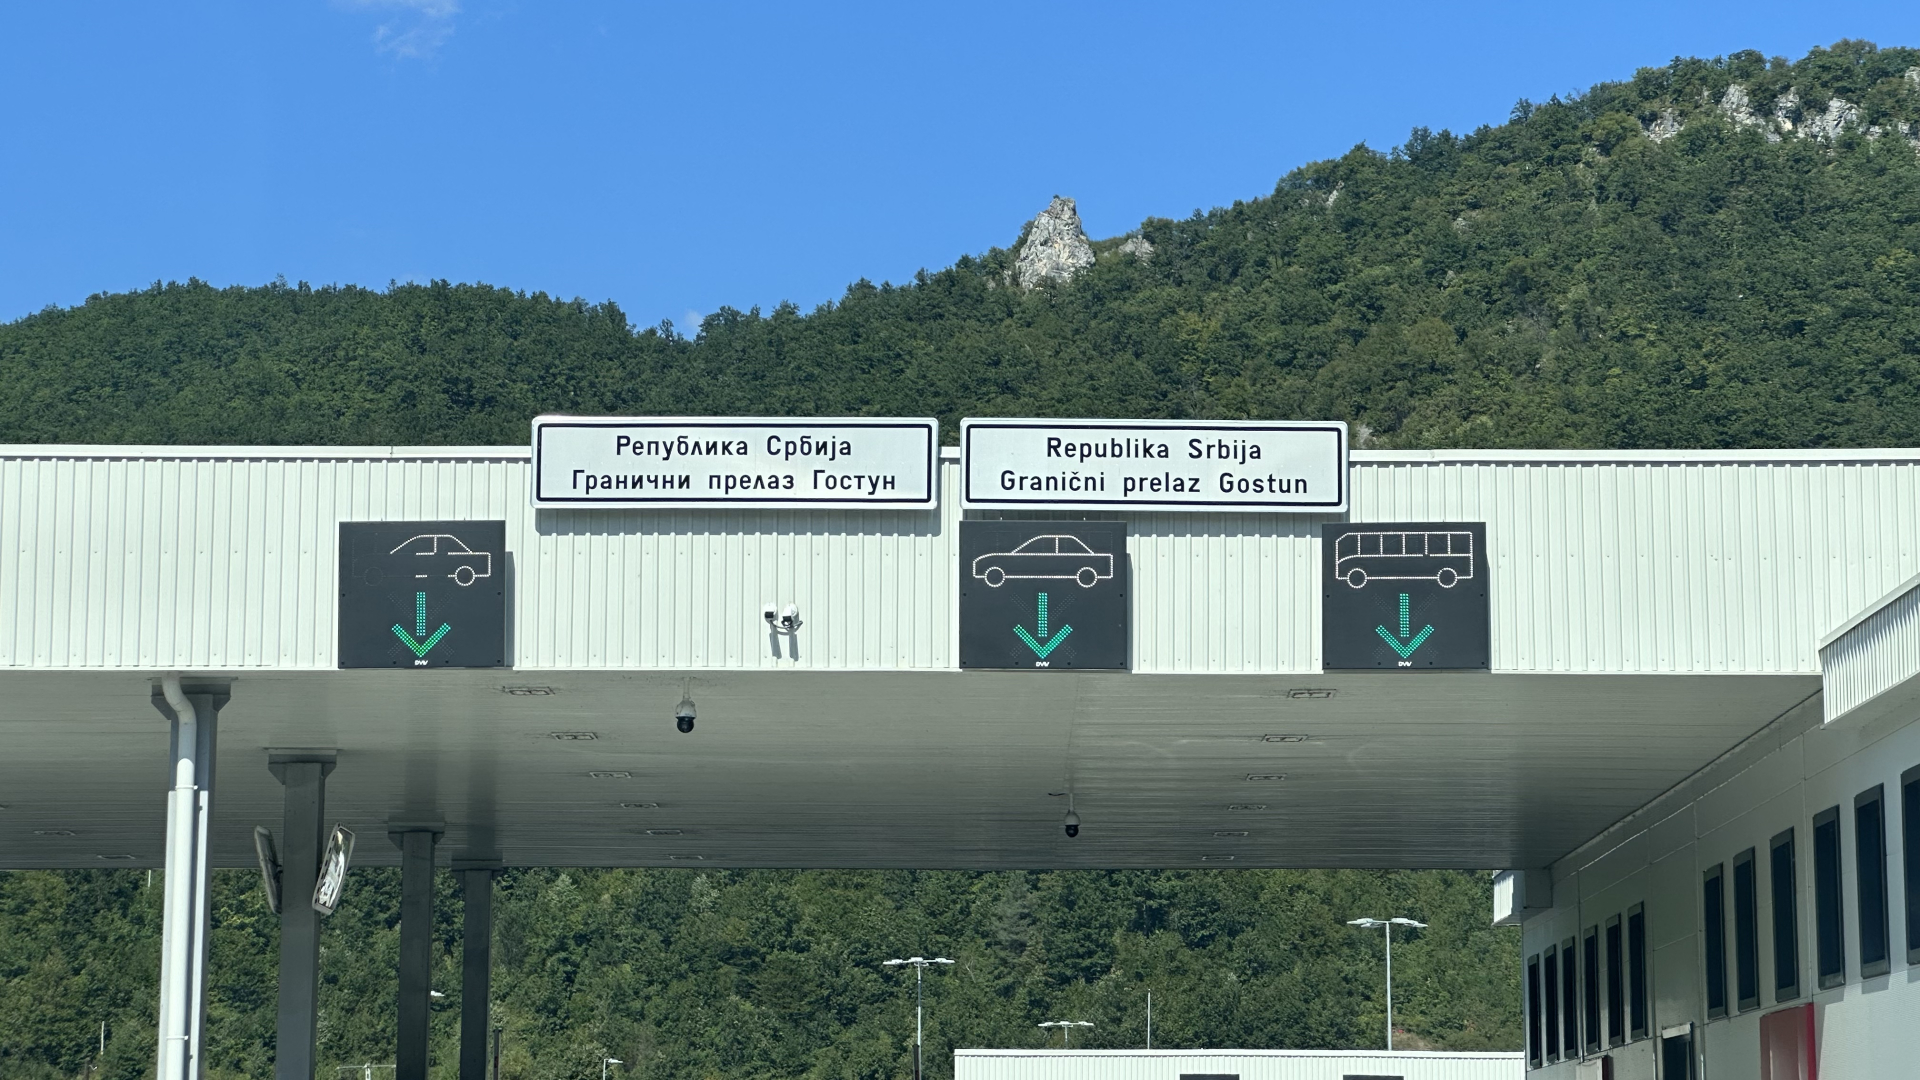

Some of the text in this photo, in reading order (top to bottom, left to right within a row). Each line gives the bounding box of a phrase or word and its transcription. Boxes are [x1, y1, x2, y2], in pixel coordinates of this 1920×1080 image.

[616, 434, 852, 462] Република Србија
[1047, 436, 1262, 464] Republika Srbija
[572, 469, 896, 496] Гранични прелаз Гостун
[1000, 469, 1308, 498] Granični prelaz Gostun
